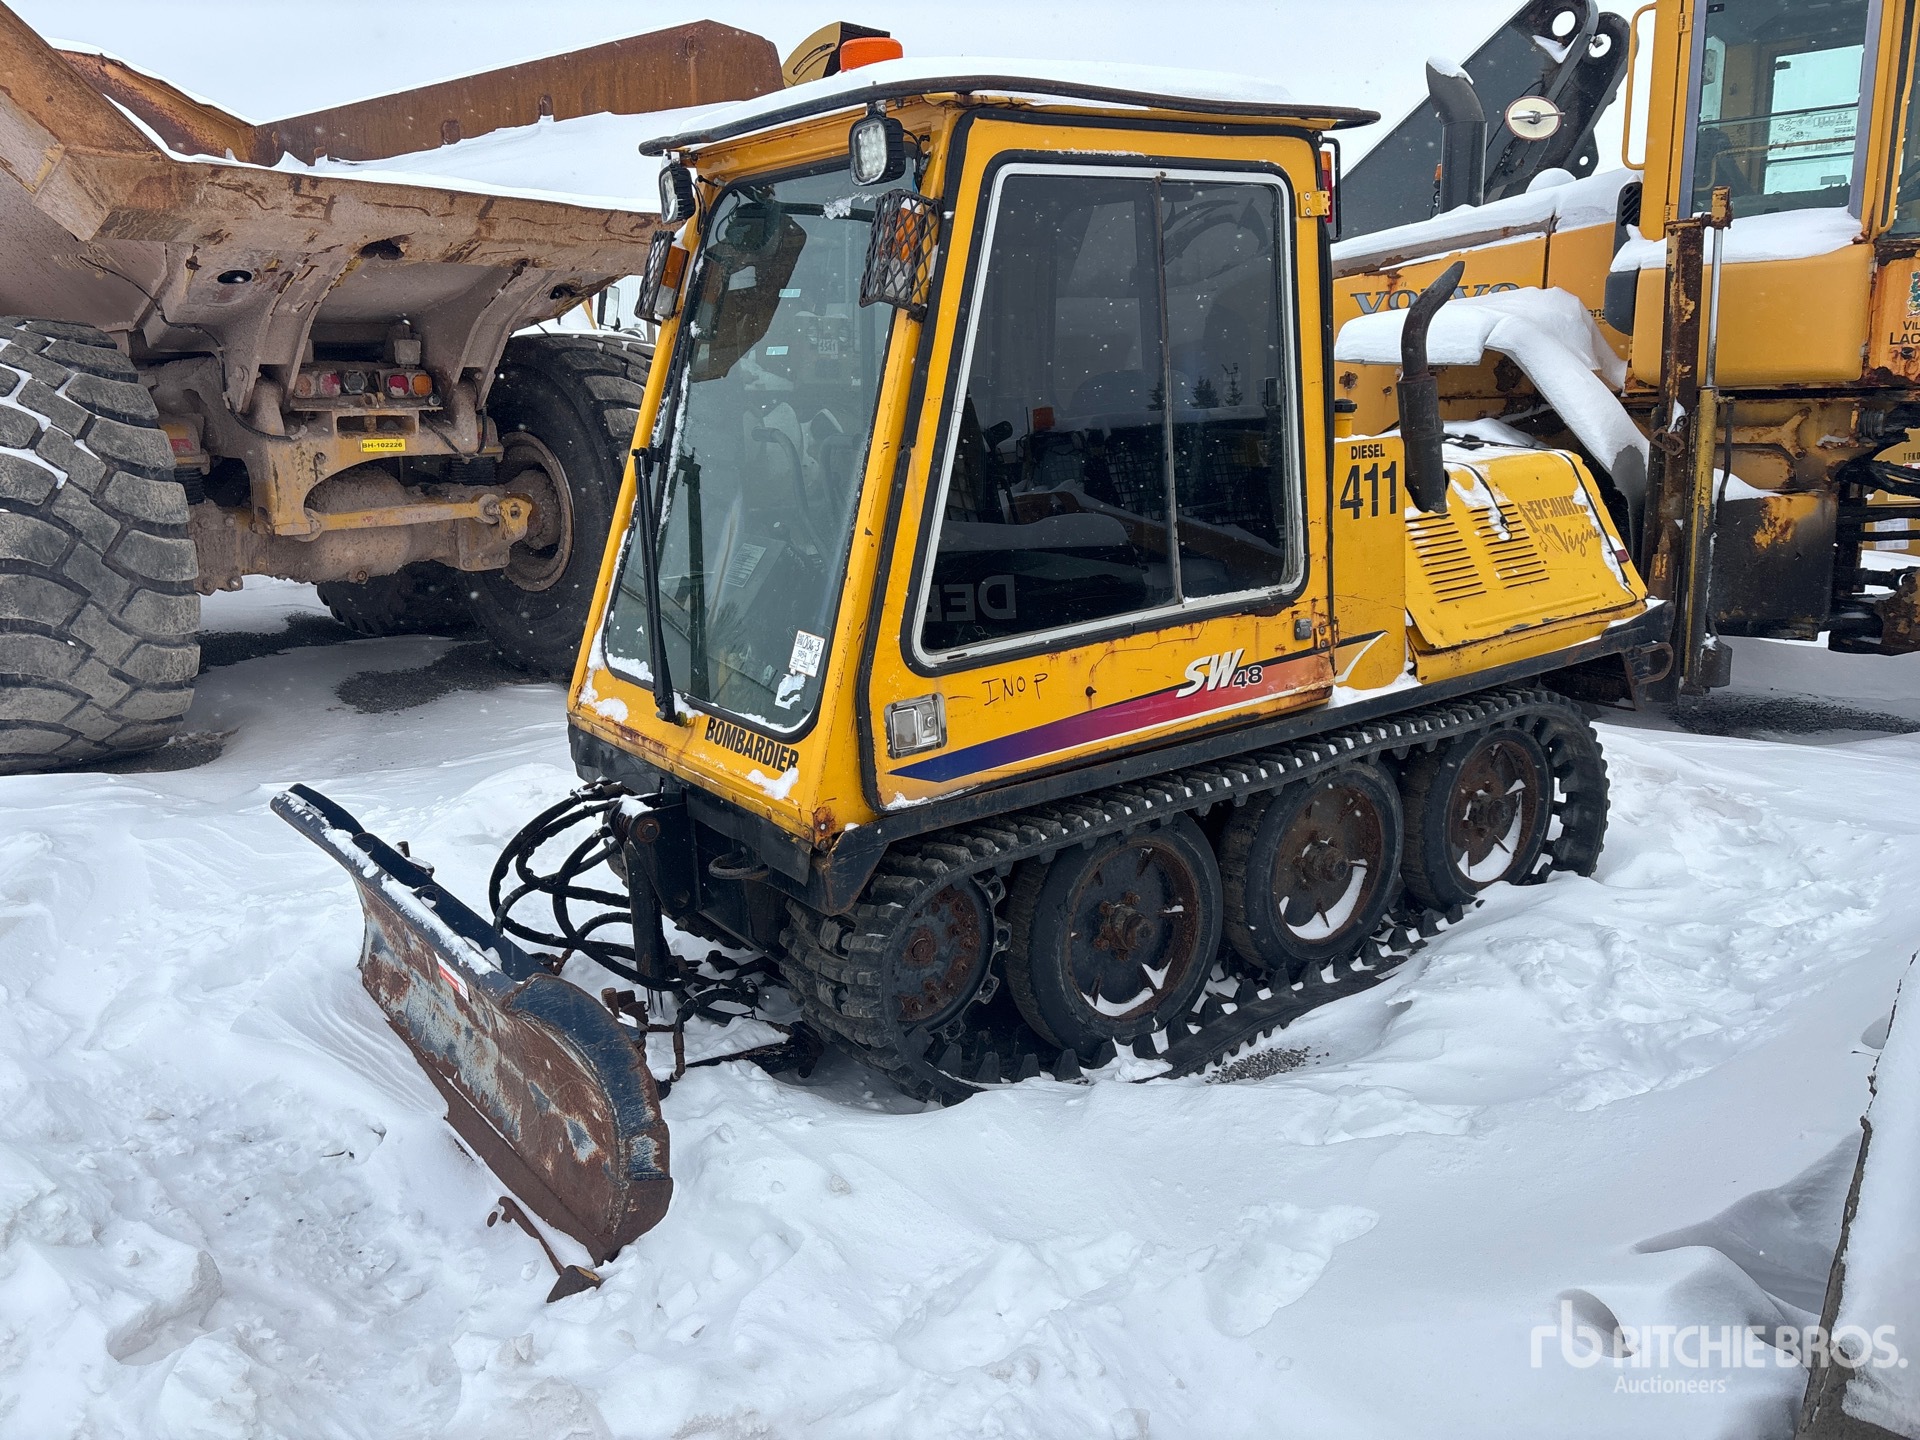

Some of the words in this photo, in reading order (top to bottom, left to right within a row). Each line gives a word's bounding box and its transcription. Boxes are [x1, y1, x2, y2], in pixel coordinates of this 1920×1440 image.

[1351, 443, 1386, 460] DIESEL
[1340, 461, 1397, 520] 411
[1175, 648, 1245, 698] SW
[1233, 665, 1264, 688] 48
[705, 717, 799, 773] BOMBARDIER
